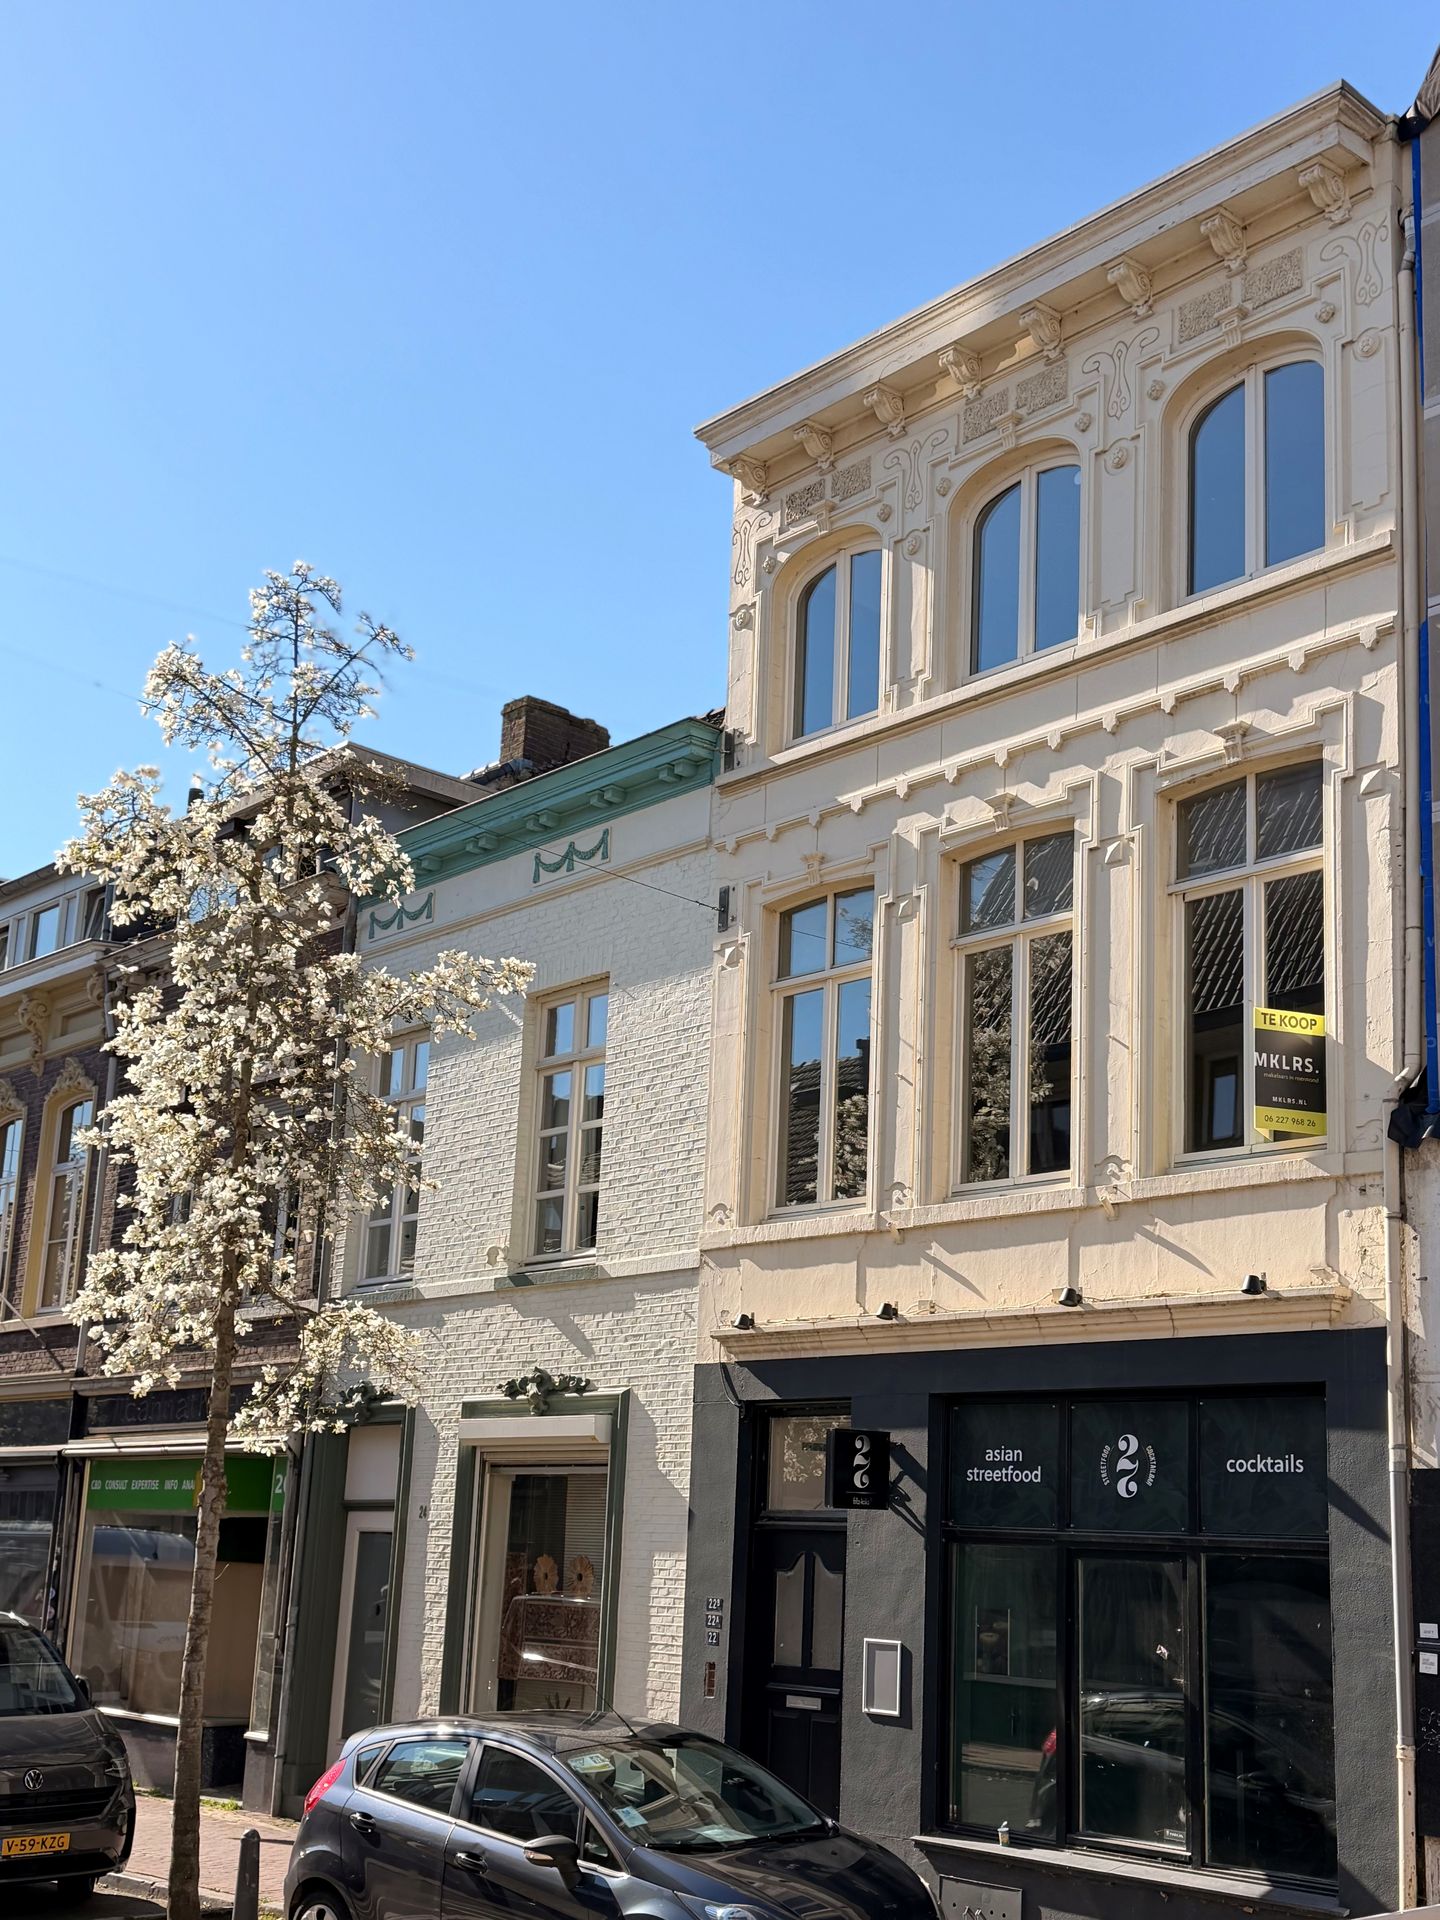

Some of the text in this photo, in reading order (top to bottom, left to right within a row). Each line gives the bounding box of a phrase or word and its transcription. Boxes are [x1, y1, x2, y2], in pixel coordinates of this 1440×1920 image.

[1261, 1012, 1317, 1030] TE KOOP
[1254, 1051, 1319, 1074] MKLRS.
[1272, 1096, 1307, 1106] MKLRS.NL
[1264, 1114, 1317, 1127] 06 227 968 26
[985, 1445, 1023, 1462] asian
[1100, 1444, 1111, 1486] STREETFOOD
[1145, 1445, 1157, 1487] COCKTAILBAR
[1226, 1453, 1304, 1473] cocktails
[966, 1465, 1041, 1483] streetfood
[105, 1479, 129, 1490] CONSULT
[131, 1479, 160, 1490] EXPERTISE
[164, 1479, 179, 1490] INFO
[707, 1614, 720, 1626] 22A
[708, 1631, 717, 1643] 22
[6, 1835, 65, 1853] V-59-KZG
